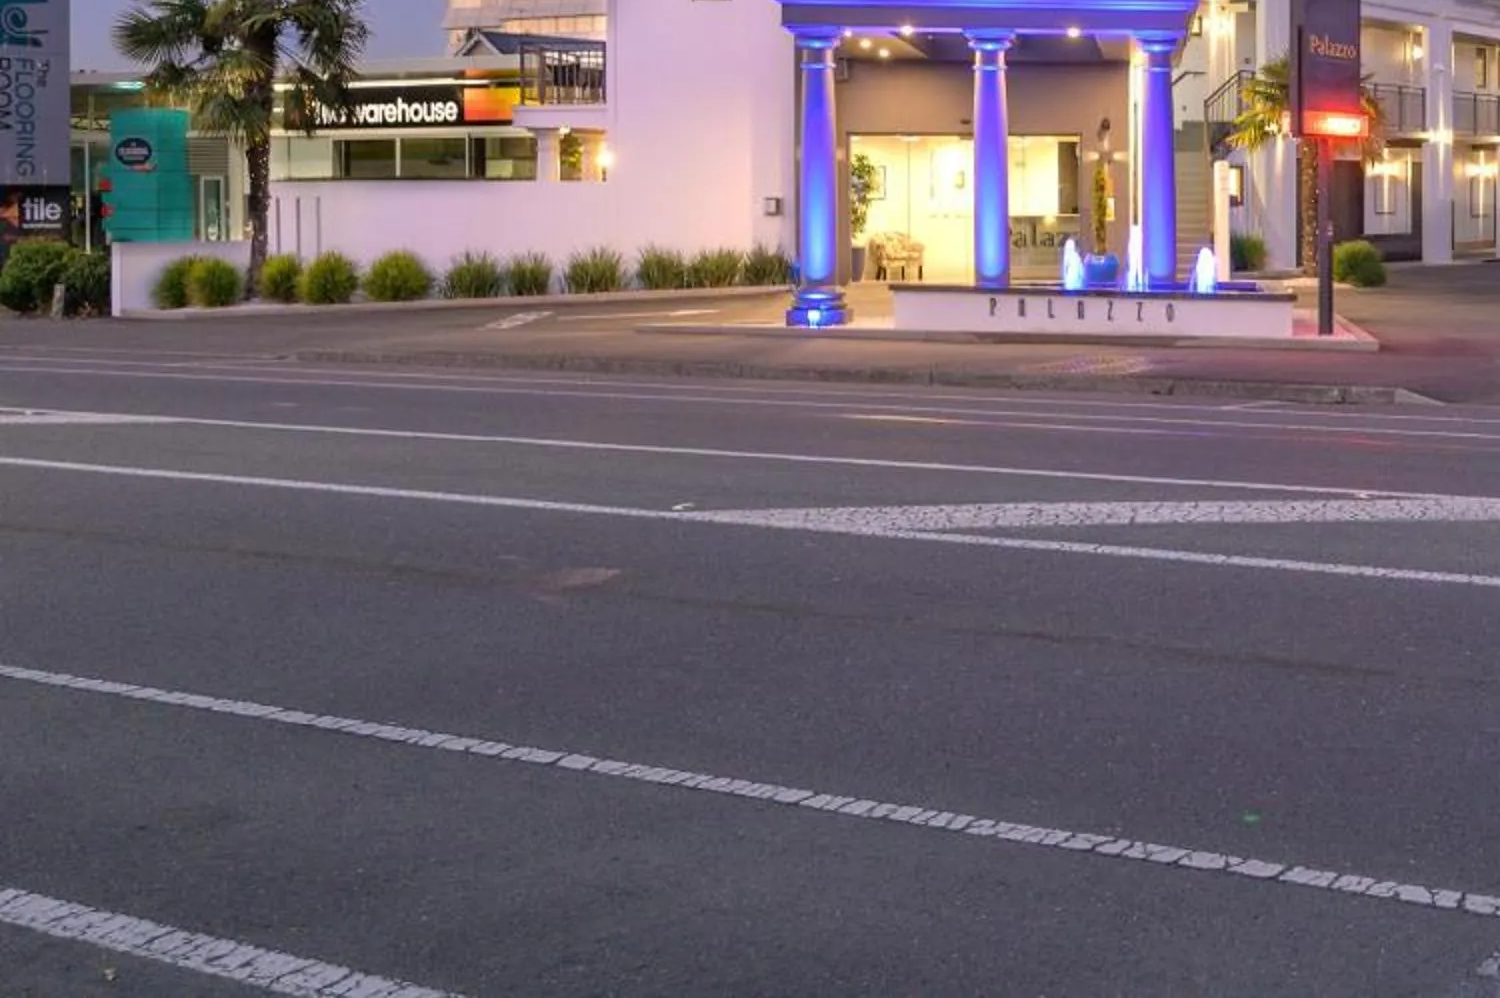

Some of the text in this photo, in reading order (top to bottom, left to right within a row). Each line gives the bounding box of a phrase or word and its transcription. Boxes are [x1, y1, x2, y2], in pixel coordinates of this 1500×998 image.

[1311, 34, 1357, 59] Palazzo
[15, 57, 35, 176] FLOORING
[22, 197, 62, 221] tile
[989, 297, 1175, 323] PALAZZO
